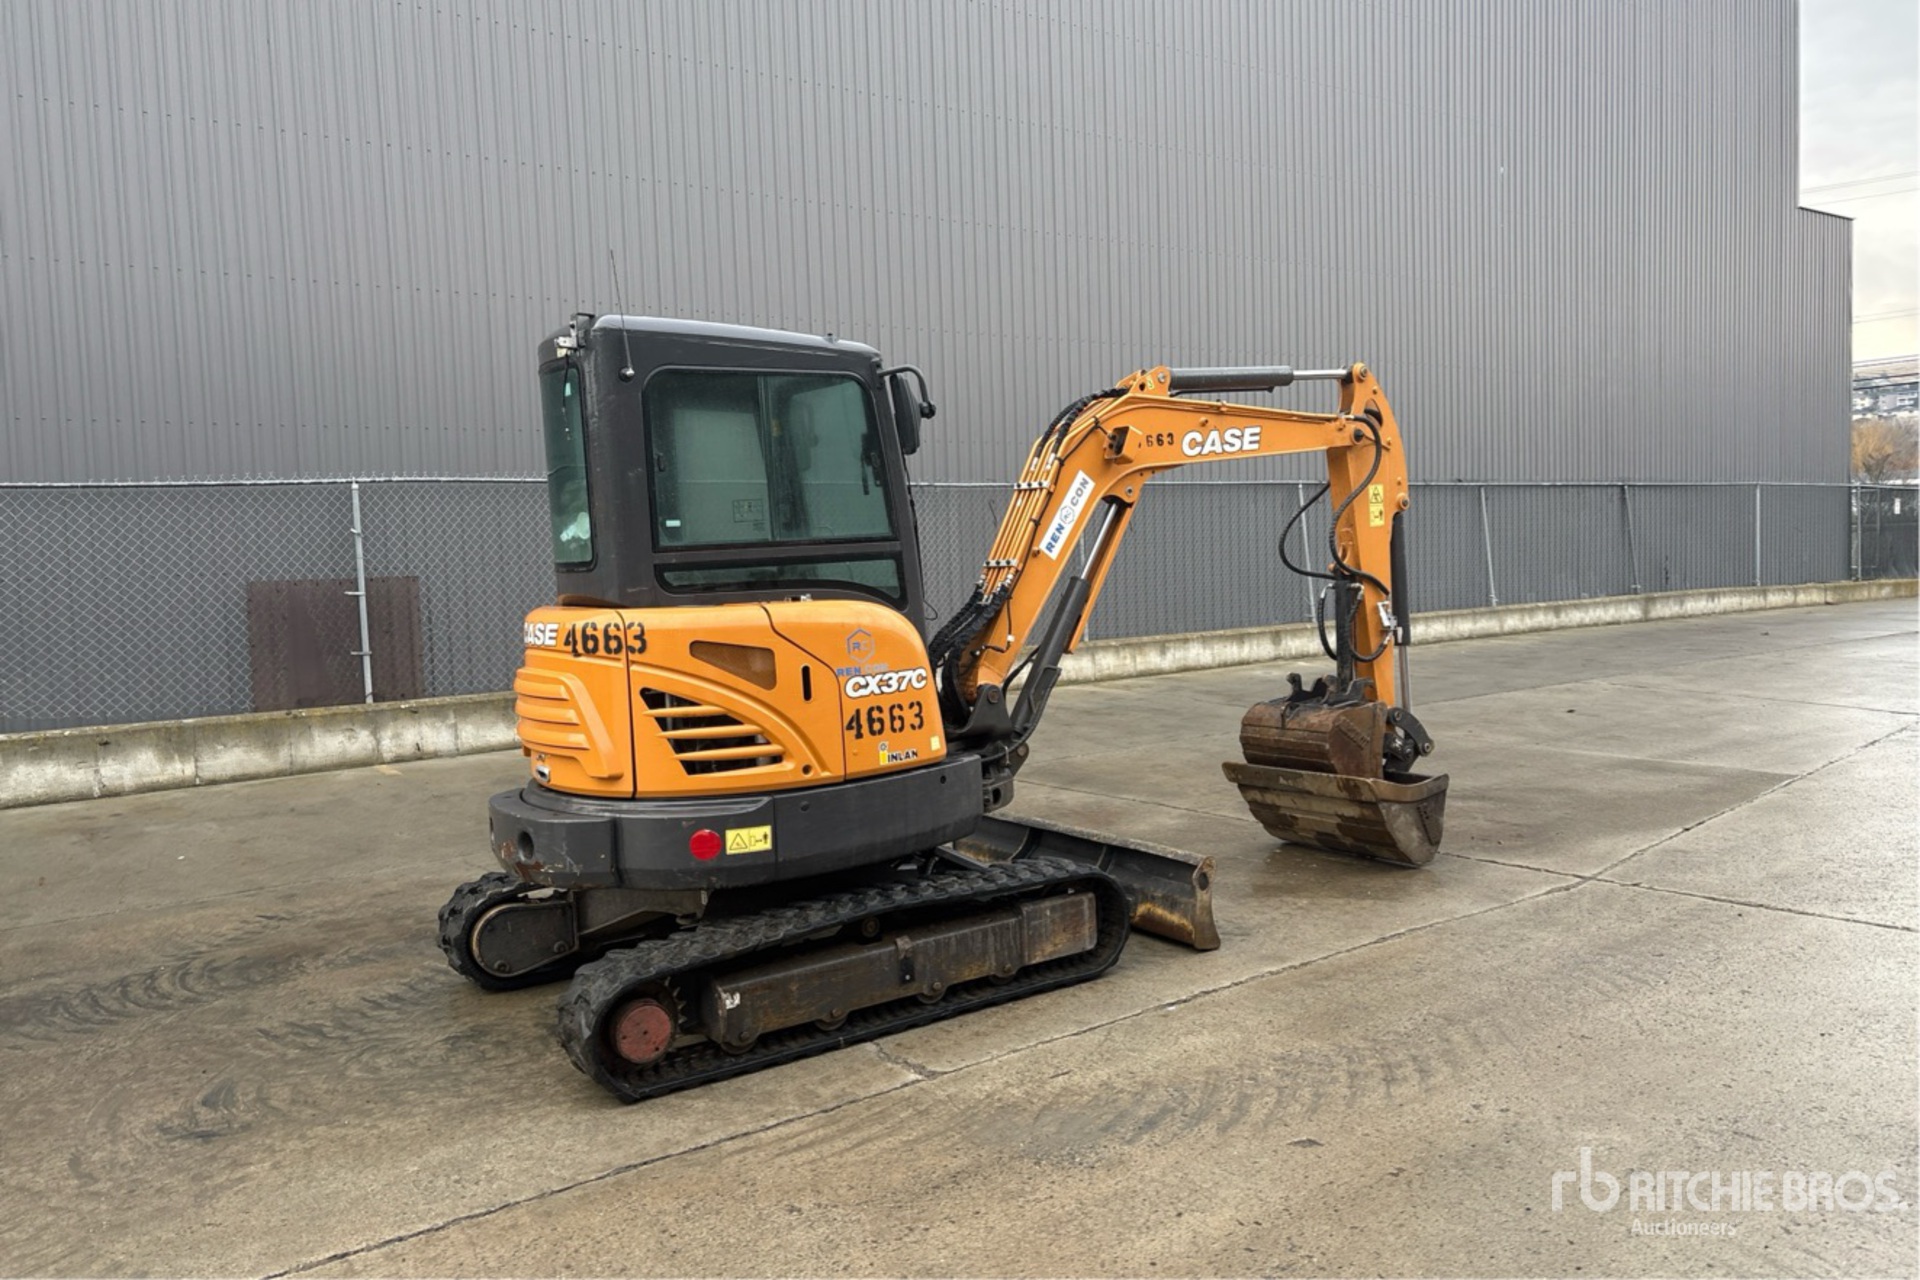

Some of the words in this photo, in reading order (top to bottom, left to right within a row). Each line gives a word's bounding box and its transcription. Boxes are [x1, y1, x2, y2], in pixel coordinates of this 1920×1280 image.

[1138, 432, 1174, 448] 663
[1182, 426, 1261, 456] CASE
[1045, 523, 1065, 553] REN
[1071, 477, 1089, 507] CON
[563, 622, 647, 657] 4663
[836, 667, 861, 677] REN
[845, 668, 927, 699] CX37C
[845, 701, 925, 740] 4663
